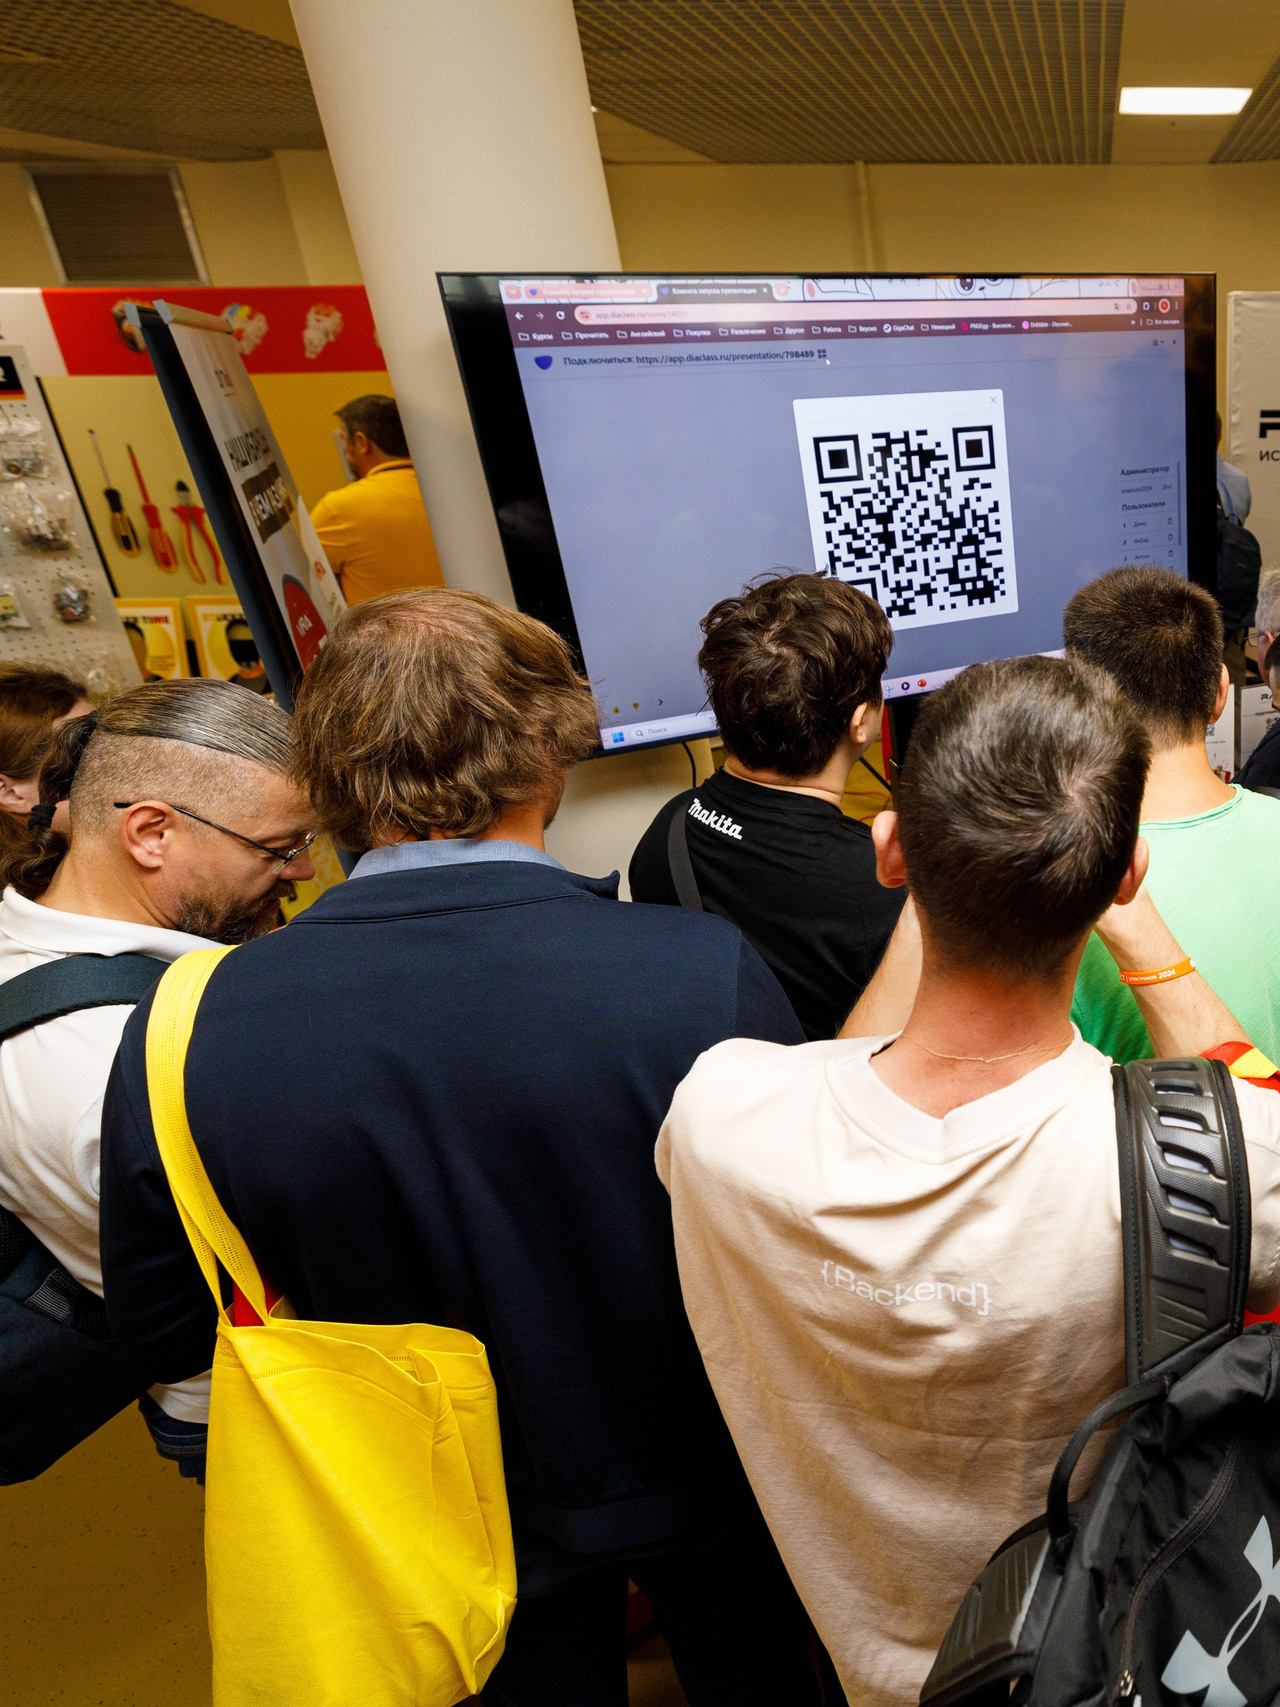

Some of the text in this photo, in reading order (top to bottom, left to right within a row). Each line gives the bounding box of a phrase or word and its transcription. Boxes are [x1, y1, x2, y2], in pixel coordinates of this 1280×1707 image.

[563, 355, 634, 367] Подключиться:
[1120, 465, 1170, 477] Администратор
[1122, 500, 1166, 512] Пользователи
[1158, 968, 1176, 979] 2024
[821, 1259, 992, 1316] {Backend}
